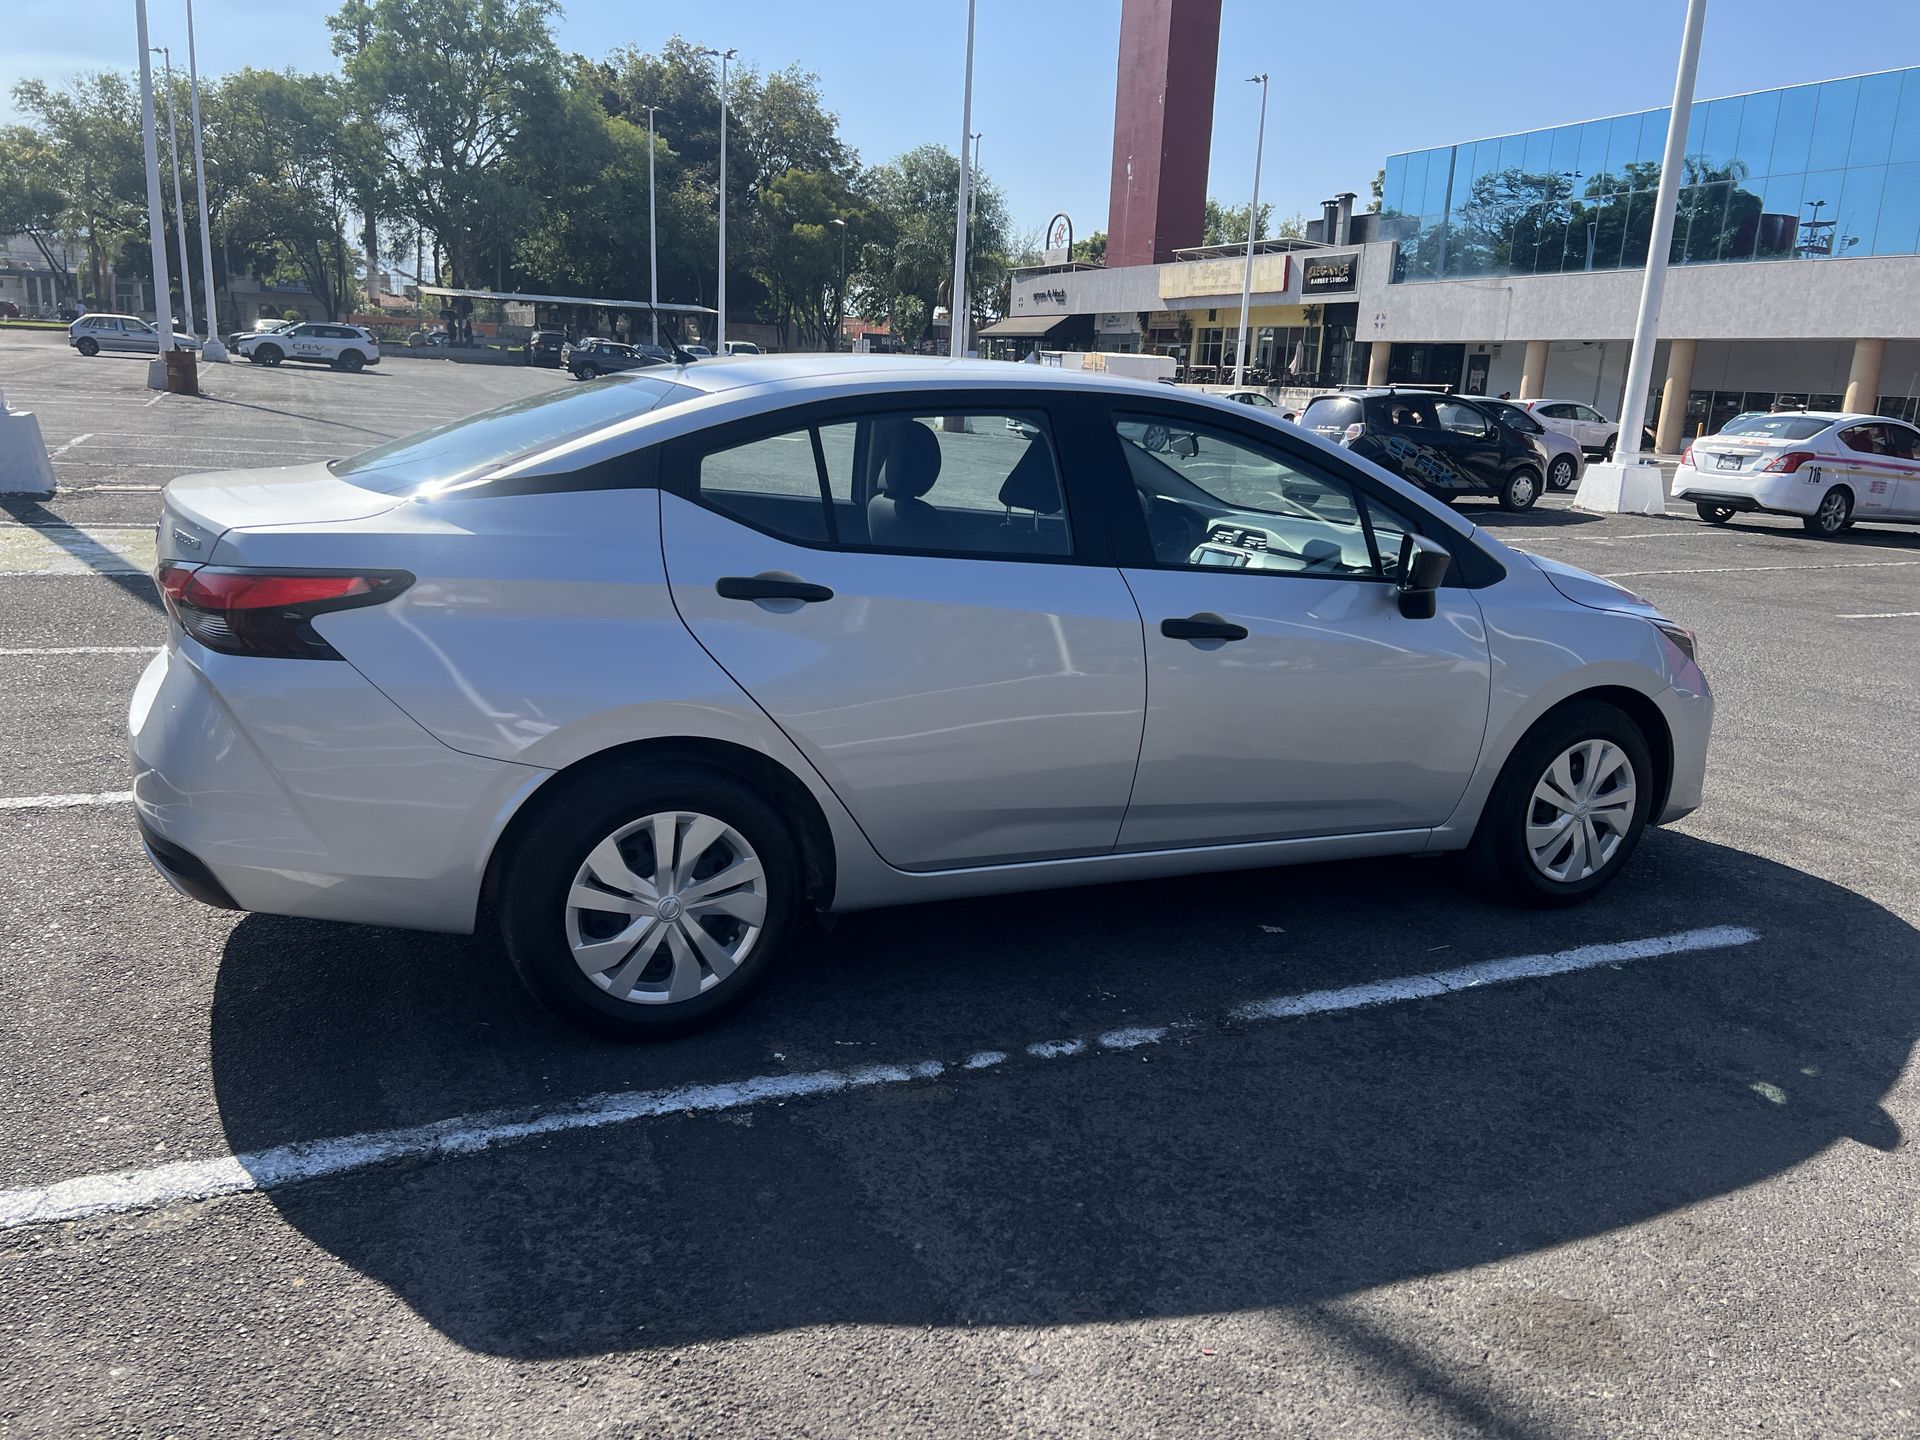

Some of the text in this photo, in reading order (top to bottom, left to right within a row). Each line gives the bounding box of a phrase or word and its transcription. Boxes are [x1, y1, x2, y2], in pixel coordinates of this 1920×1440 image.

[292, 343, 325, 351] CR-V
[1388, 436, 1462, 489] SPARK
[1808, 466, 1822, 484] 716
